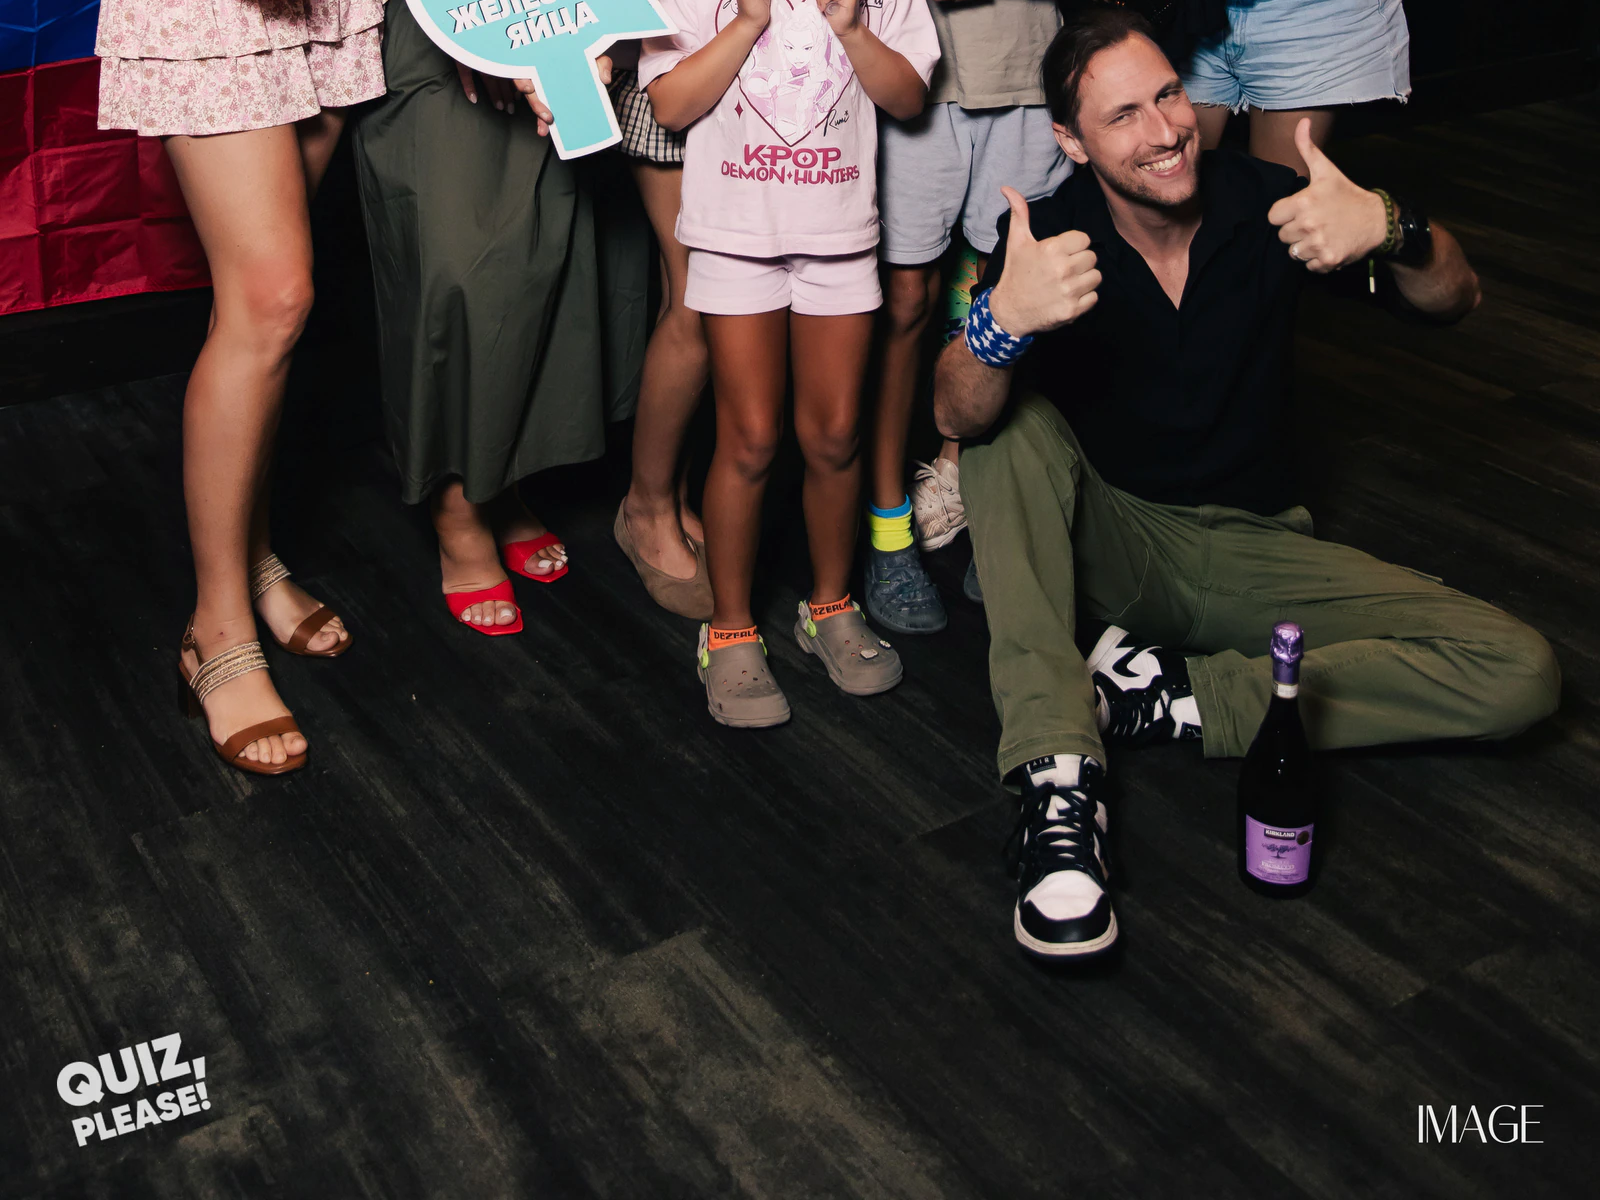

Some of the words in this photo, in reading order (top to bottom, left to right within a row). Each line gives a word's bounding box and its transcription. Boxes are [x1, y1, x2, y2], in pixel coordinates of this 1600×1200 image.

[505, 0, 599, 49] ЯЙЦА
[743, 144, 841, 169] KPOP
[721, 160, 786, 184] DEMON
[794, 164, 860, 185] HUNTERS
[1032, 756, 1050, 767] AIR
[1265, 829, 1296, 838] KIRKLAND
